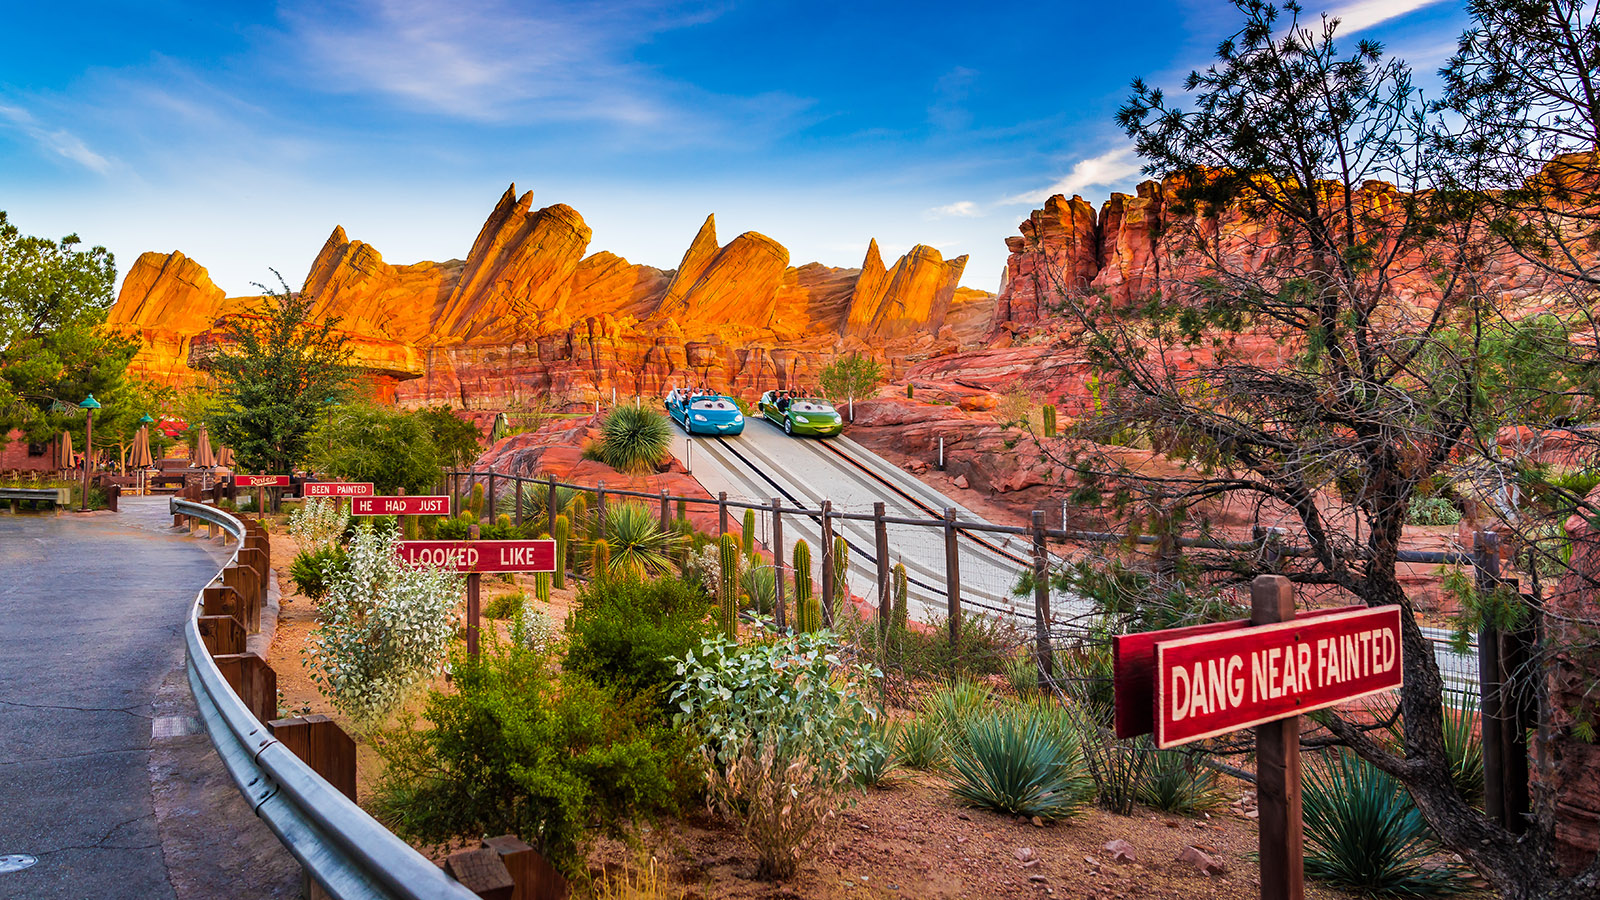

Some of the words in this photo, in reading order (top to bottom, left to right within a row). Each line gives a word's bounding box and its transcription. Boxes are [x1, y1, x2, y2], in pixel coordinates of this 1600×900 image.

[311, 485, 329, 494] BEEN
[337, 485, 366, 494] PAINTED
[359, 500, 372, 512] HE
[385, 500, 407, 512] HAD
[419, 500, 442, 512] JUST
[410, 548, 479, 567] LOOKED
[501, 547, 535, 566] LIKE
[1171, 655, 1245, 722] DANG
[1251, 642, 1312, 703] NEAR
[1317, 627, 1396, 688] FAINTED
